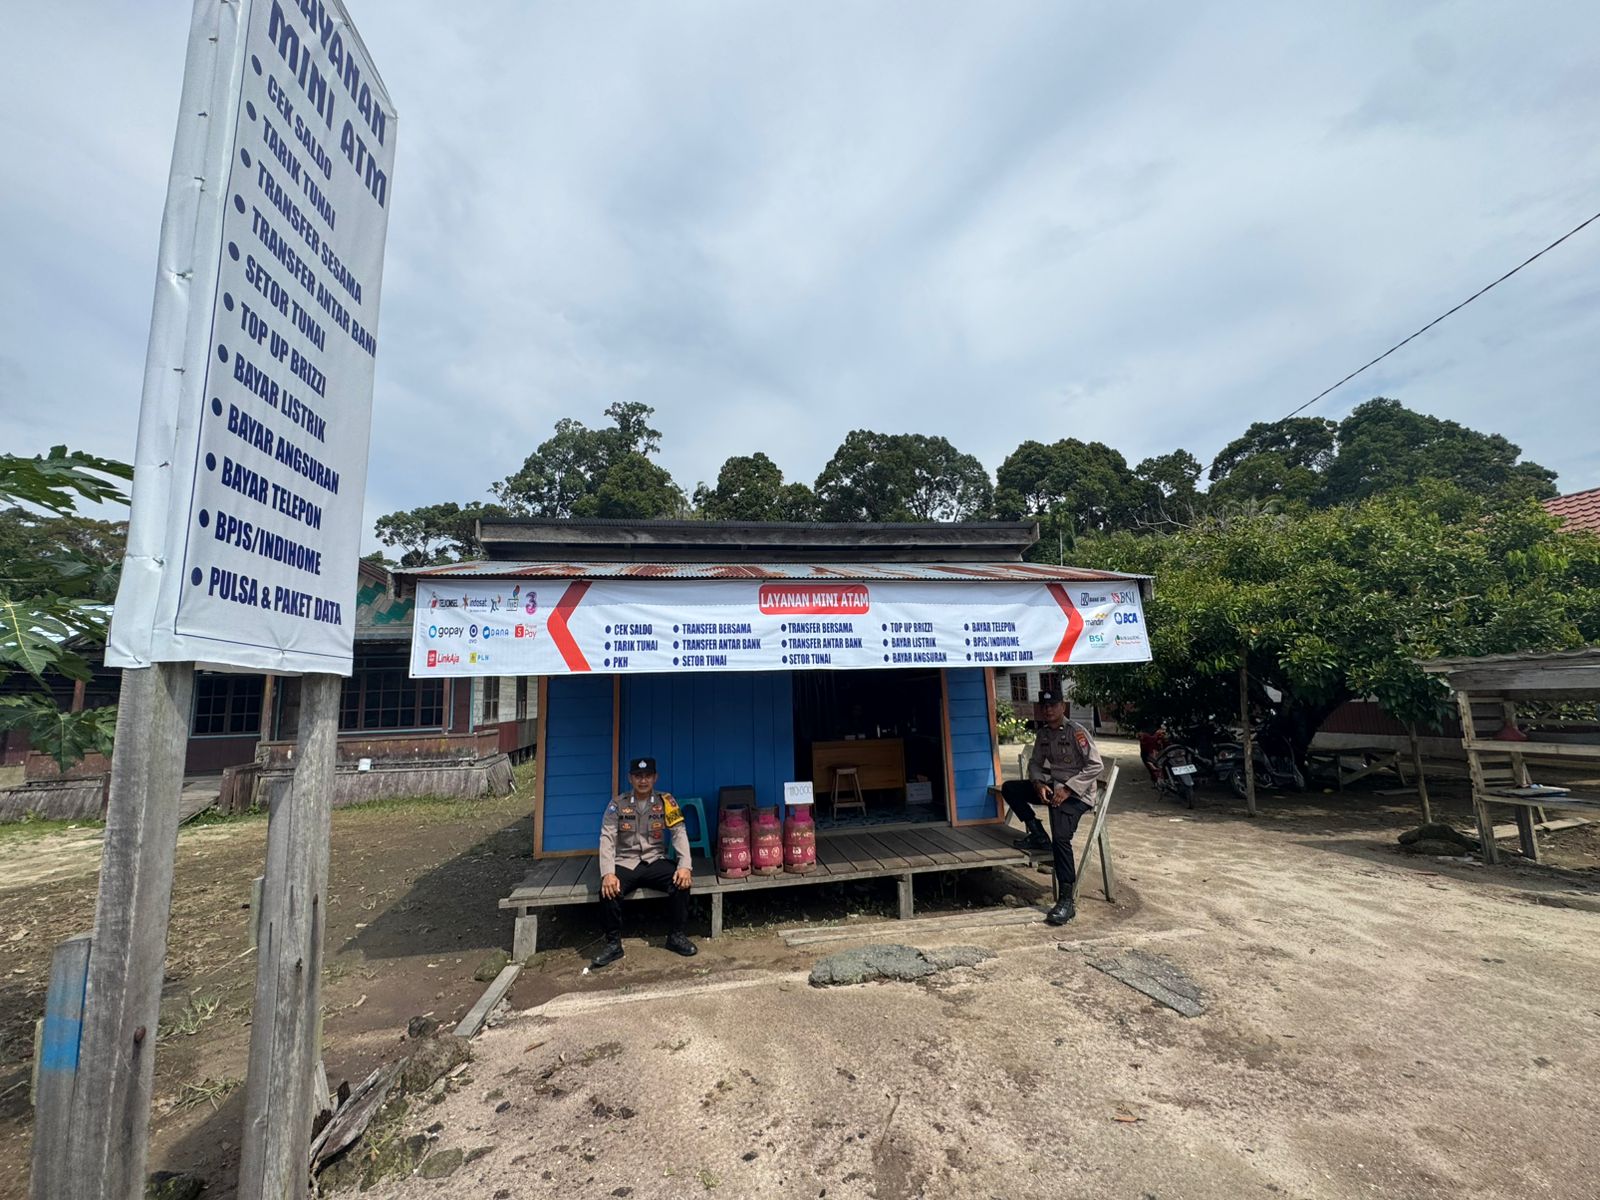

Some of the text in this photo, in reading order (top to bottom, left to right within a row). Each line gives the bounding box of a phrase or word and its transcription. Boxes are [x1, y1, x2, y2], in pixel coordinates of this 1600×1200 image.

[295, 0, 386, 147] AYANAN
[269, 0, 386, 208] MINI ATM
[268, 74, 332, 181] CEK SALDO
[264, 115, 335, 231] TARIK TUNAI
[258, 160, 361, 306] TRANSFER SESAMA
[253, 206, 315, 297] TRANSFER
[317, 282, 350, 333] ANTAR
[246, 255, 325, 352] SETOR TUNAI
[241, 302, 327, 398] TOP UP BRIZZI
[234, 352, 327, 444] BAYAR LISTRIK
[228, 402, 339, 496] BAYAR ANGSURAN
[221, 455, 321, 531] BAYAR TELEPON
[214, 511, 321, 576] BPJS/INDIHOME
[208, 567, 341, 625] PULSA & PAKET DATA
[761, 592, 869, 608] LAYANAN MINI ATAM
[1120, 592, 1135, 604] BNI
[1124, 613, 1138, 624] BCA
[438, 626, 464, 638] gopay
[614, 624, 652, 635] CEK SALDO
[682, 623, 751, 634] TRANSFER BERSAMA
[788, 622, 853, 634] TRANSFER BERSAMA
[890, 622, 933, 633] TOP UP BRIZZI
[972, 622, 1015, 632] BAYAR TELEPON
[525, 629, 537, 639] Pay
[613, 640, 658, 651] TARIK TUNAI
[682, 638, 761, 650] TRANSFER ANTAR BANK
[788, 638, 863, 649] TRANSFER ANTAR BANK
[891, 637, 937, 648] BAYAR LISTRIK
[437, 653, 460, 664] LinkAja
[613, 657, 628, 668] PKH
[682, 655, 727, 667] SETOR TUNAI
[789, 653, 831, 664] SETOR TUNAI
[892, 652, 947, 663] BAYAR ANGSURAN
[974, 651, 1034, 662] PULSA & PAKET DATA
